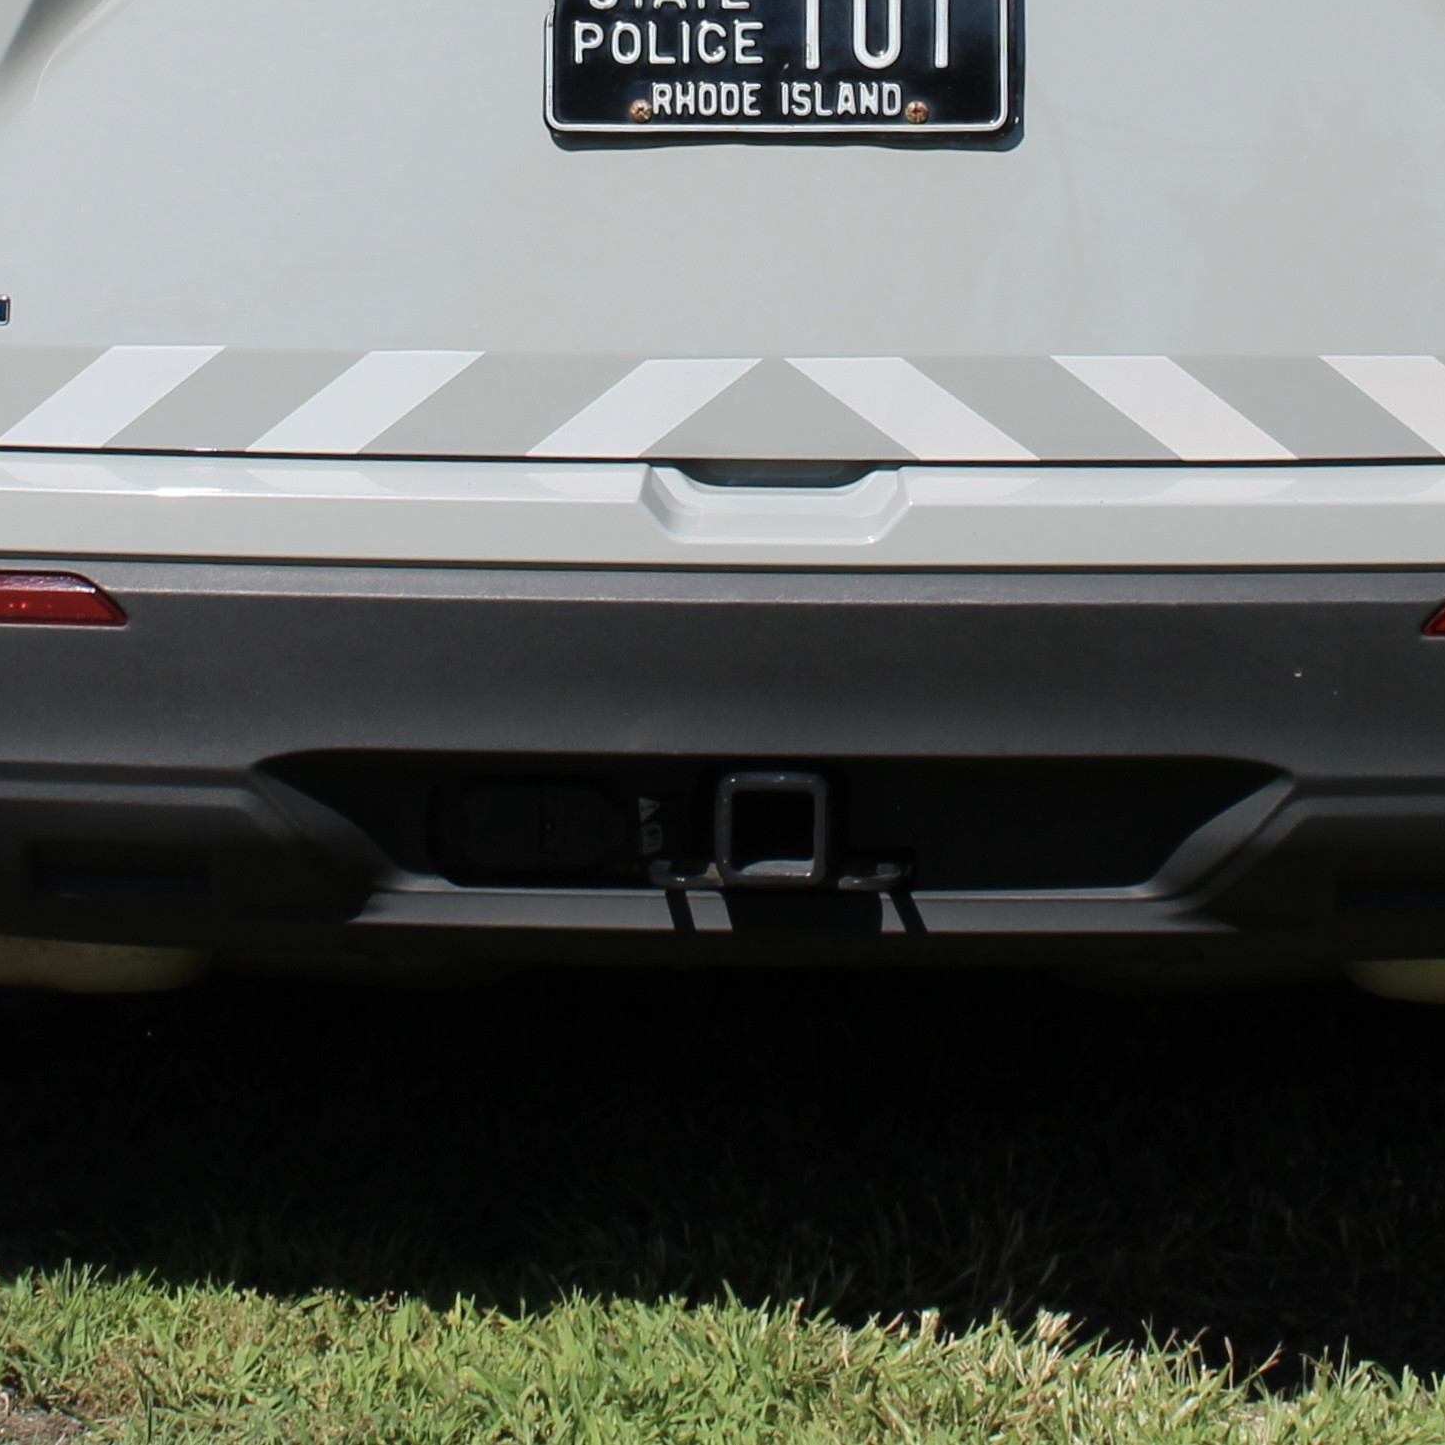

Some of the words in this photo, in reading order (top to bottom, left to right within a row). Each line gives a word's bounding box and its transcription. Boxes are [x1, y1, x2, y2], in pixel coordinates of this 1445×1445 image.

[573, 19, 765, 66] POLICE
[651, 82, 762, 118] RHODE
[780, 82, 903, 118] ISLAND
